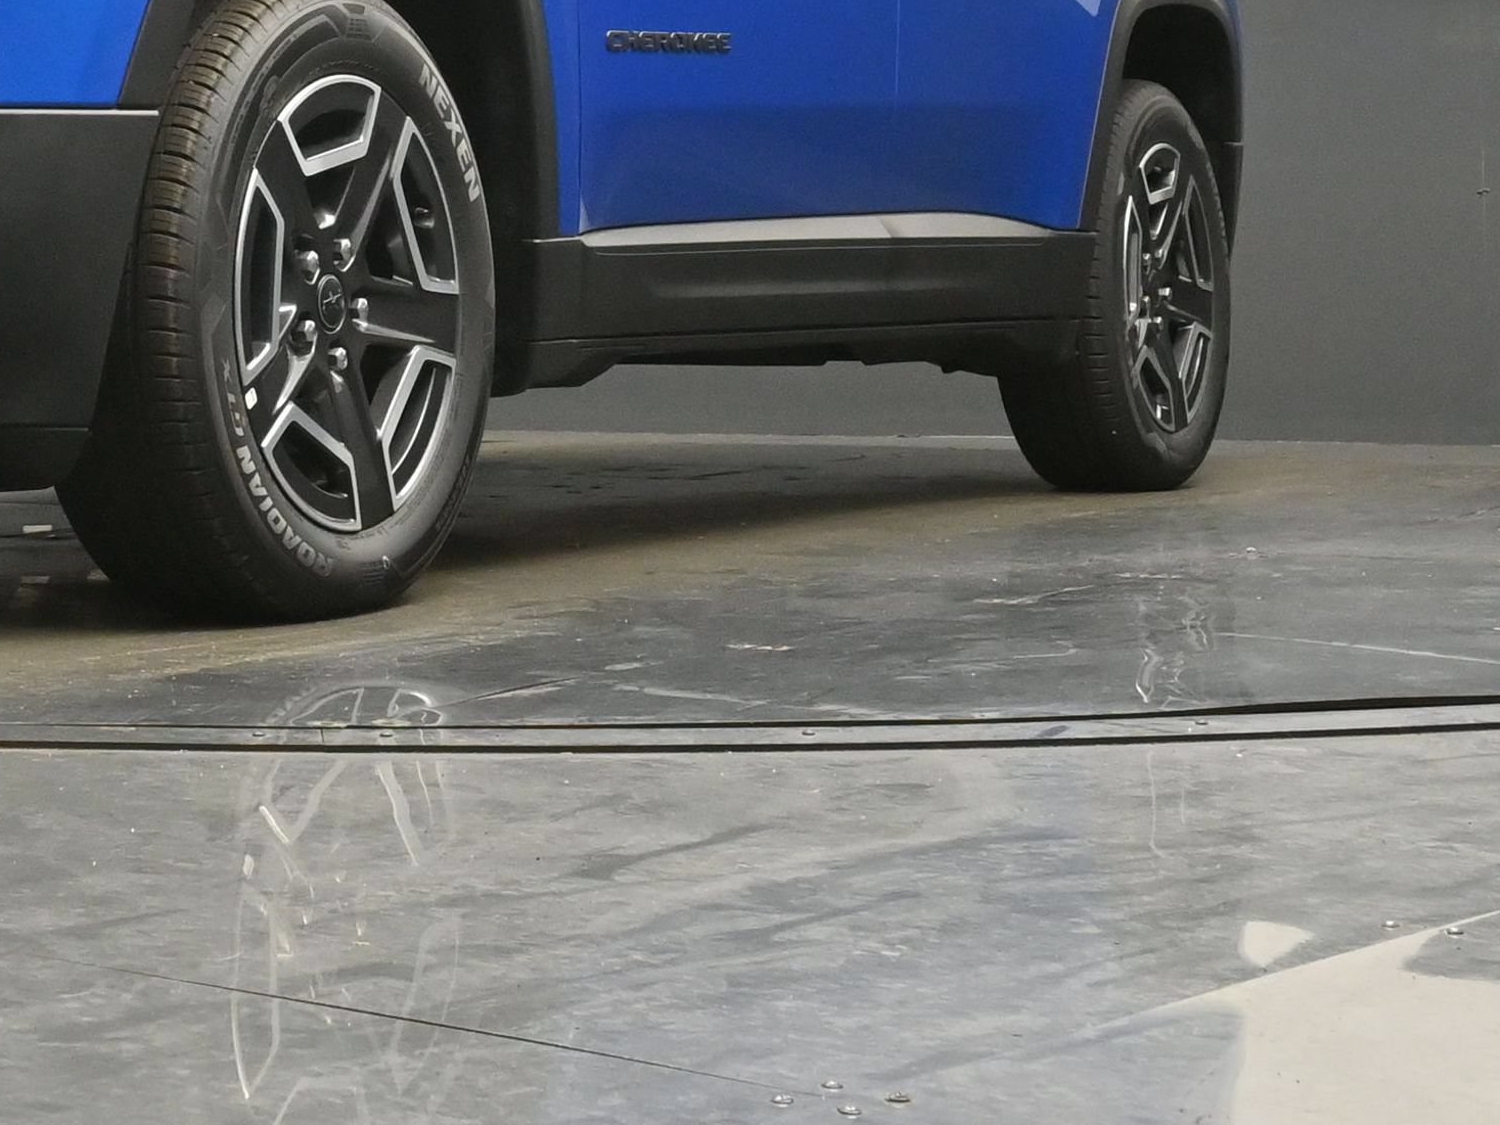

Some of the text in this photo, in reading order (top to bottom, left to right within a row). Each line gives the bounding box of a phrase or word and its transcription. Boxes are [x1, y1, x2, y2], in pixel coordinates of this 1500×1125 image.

[606, 30, 732, 54] CHEROKEE
[418, 62, 481, 203] NEXEN
[236, 445, 334, 577] ROADIAN
